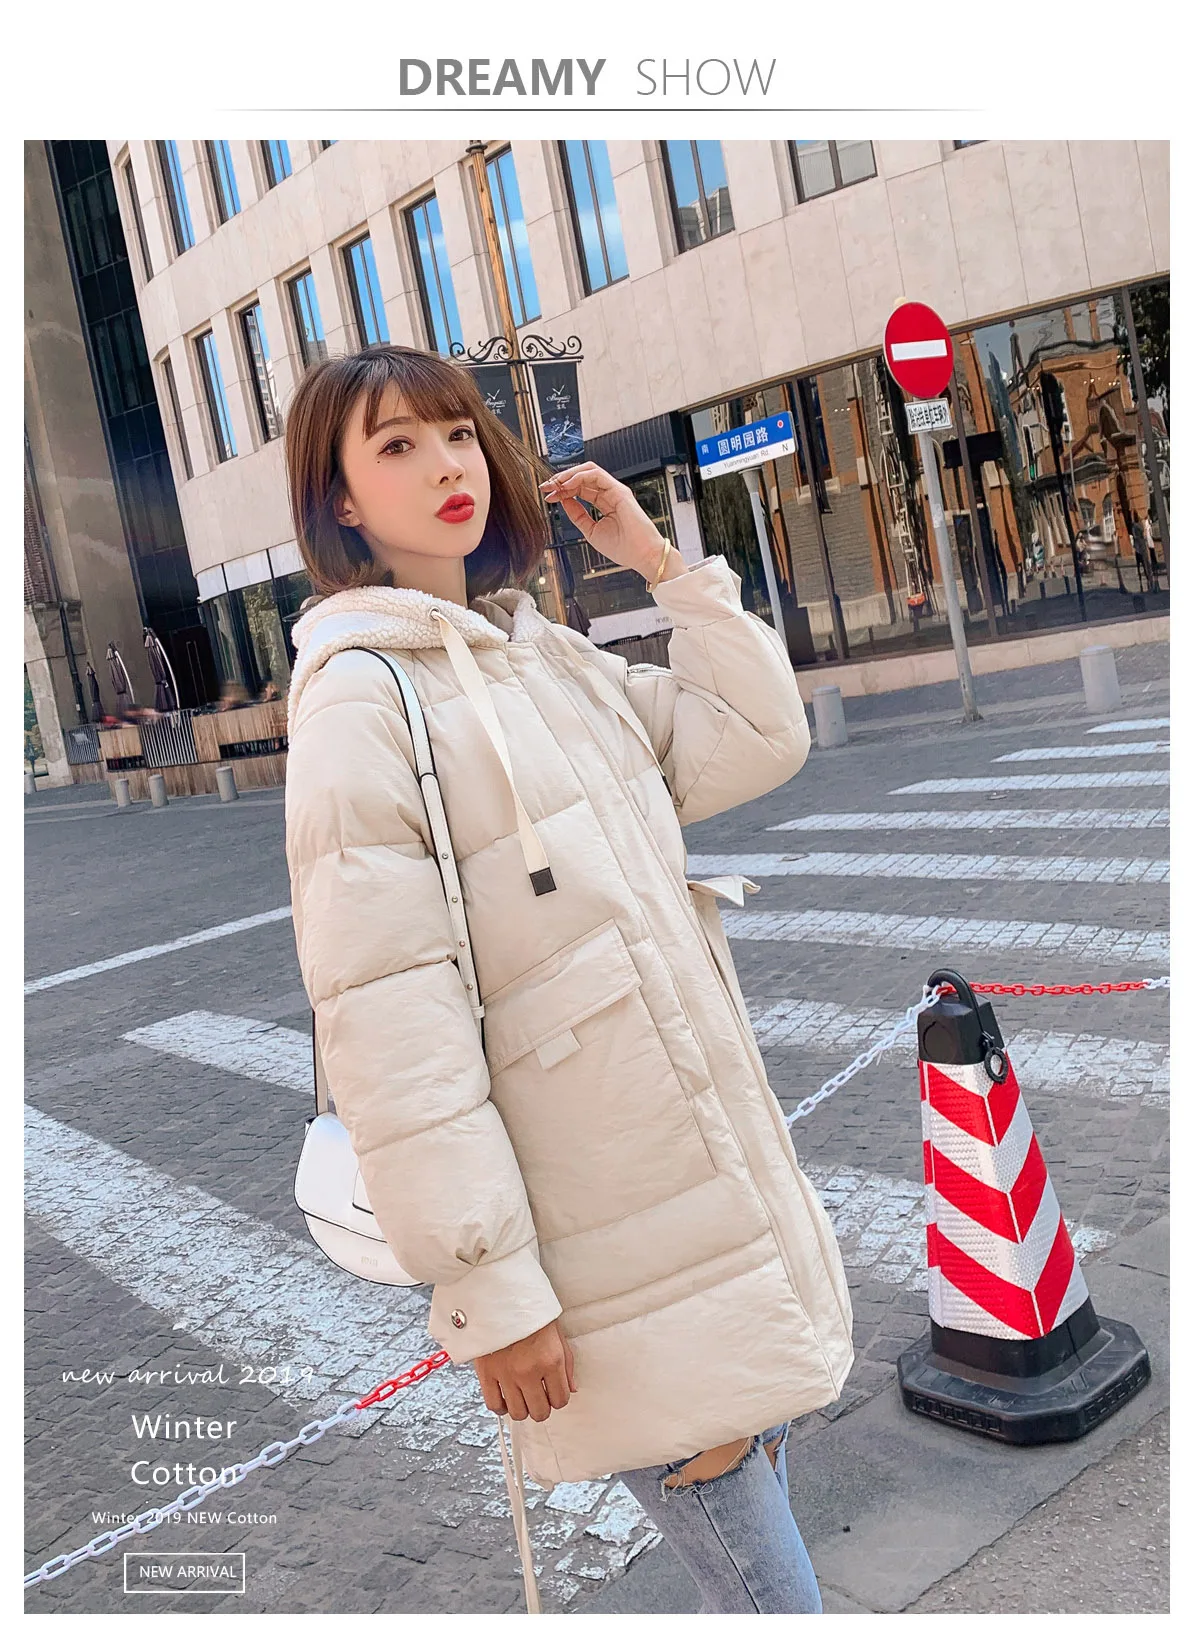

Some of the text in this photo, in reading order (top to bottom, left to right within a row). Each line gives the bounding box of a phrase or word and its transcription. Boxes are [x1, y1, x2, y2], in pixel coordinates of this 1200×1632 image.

[717, 426, 769, 456] 圆明园路
[706, 467, 713, 476] S
[723, 453, 760, 469] Yuanmingyuan
[781, 443, 789, 453] N
